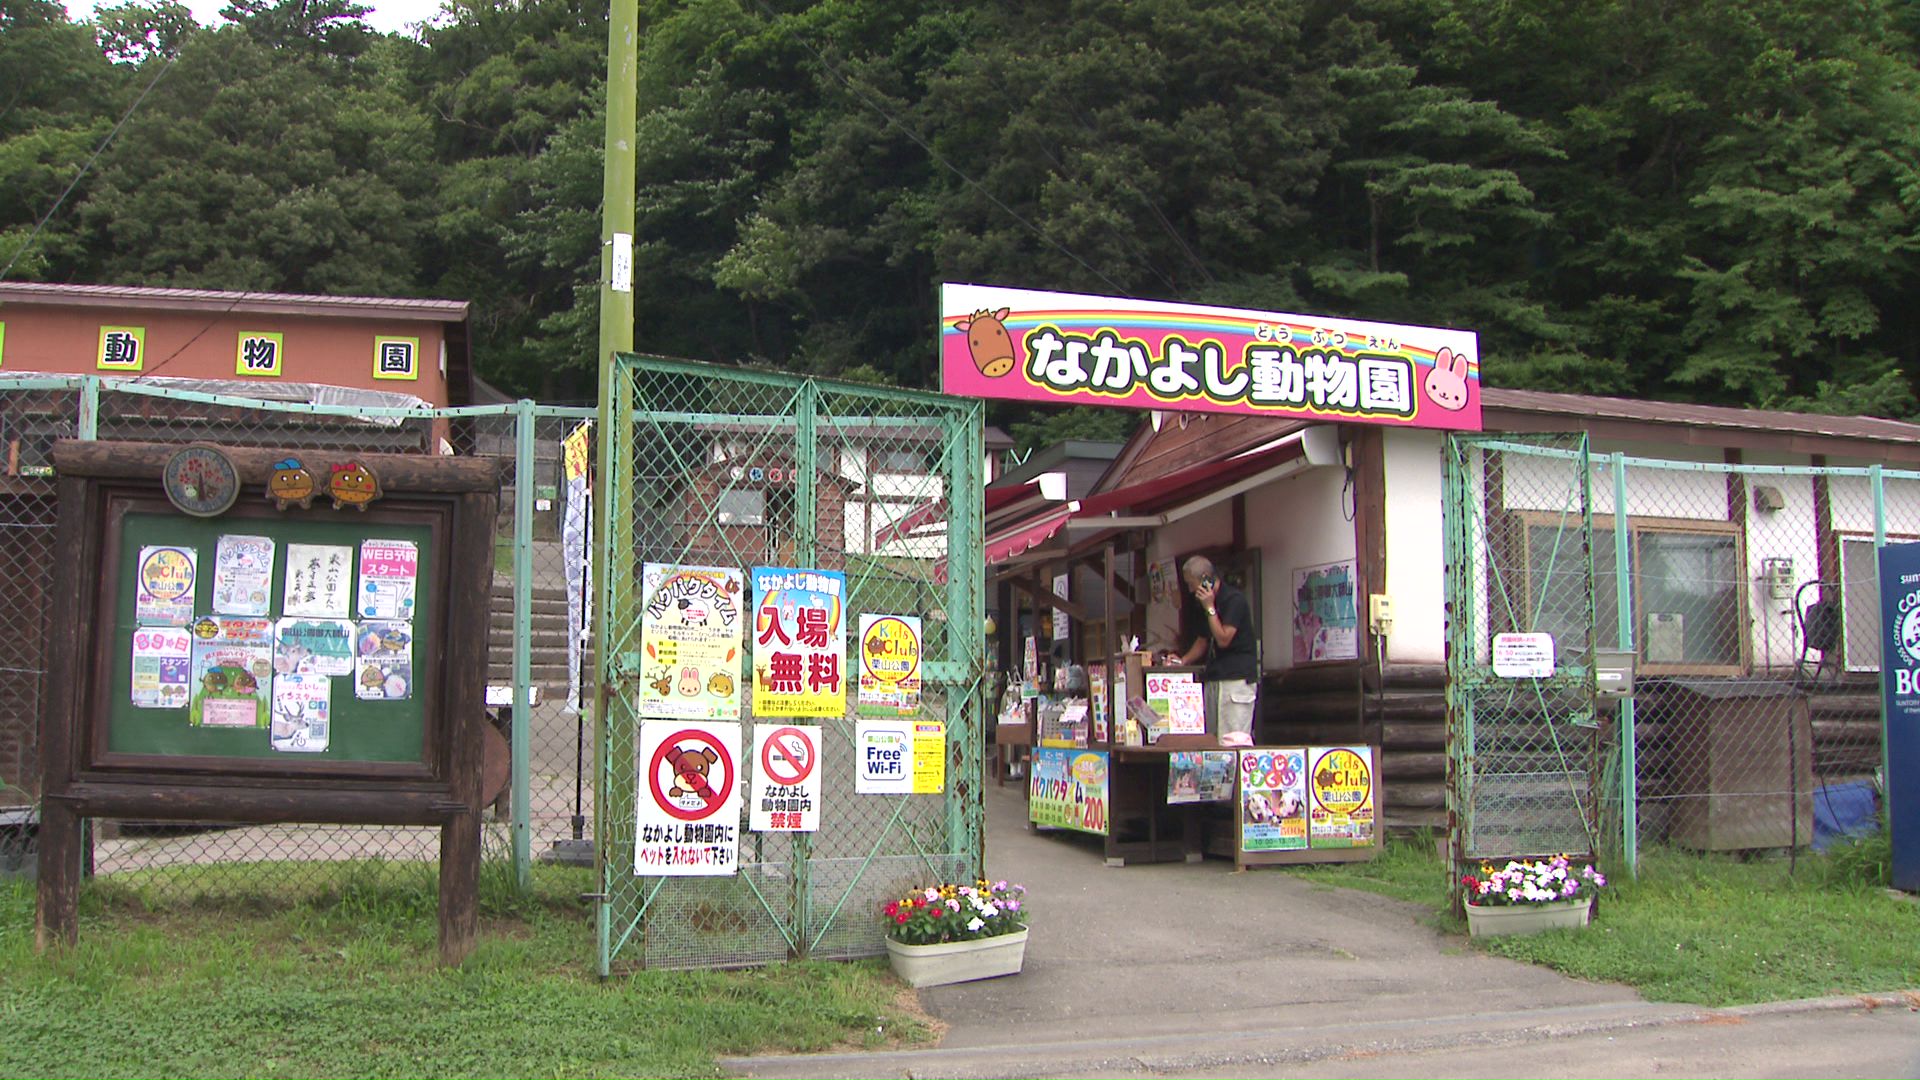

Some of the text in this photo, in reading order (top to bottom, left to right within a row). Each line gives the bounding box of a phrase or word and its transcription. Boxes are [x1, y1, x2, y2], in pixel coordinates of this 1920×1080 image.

[1258, 325, 1398, 350] どう ぶつ えん
[1031, 332, 1412, 412] なかよし動物園
[362, 549, 417, 561] WEB予約
[160, 566, 193, 580] Club
[367, 564, 410, 575] スタート
[757, 573, 841, 597] なかよし動物園
[1900, 573, 1920, 584] sun
[647, 576, 737, 627] パクパクタイム
[758, 607, 828, 648] 入場
[880, 623, 909, 640] Kids
[883, 639, 917, 657] Club
[771, 651, 840, 693] 無料
[867, 746, 902, 760] Free
[867, 761, 902, 774] Wi-Fi
[1243, 755, 1302, 773] にんじん
[1329, 754, 1359, 770] Kids
[1250, 770, 1296, 786] すくい
[1333, 770, 1368, 786] Club
[765, 785, 809, 798] なかよし
[1031, 776, 1083, 804] パクパクタイム
[761, 799, 812, 812] 動物園内
[1083, 796, 1104, 830] 200
[770, 813, 803, 829] 禁煙
[642, 823, 734, 844] なかよし動物園内に
[640, 847, 733, 866] ペットを入れないで下さい
